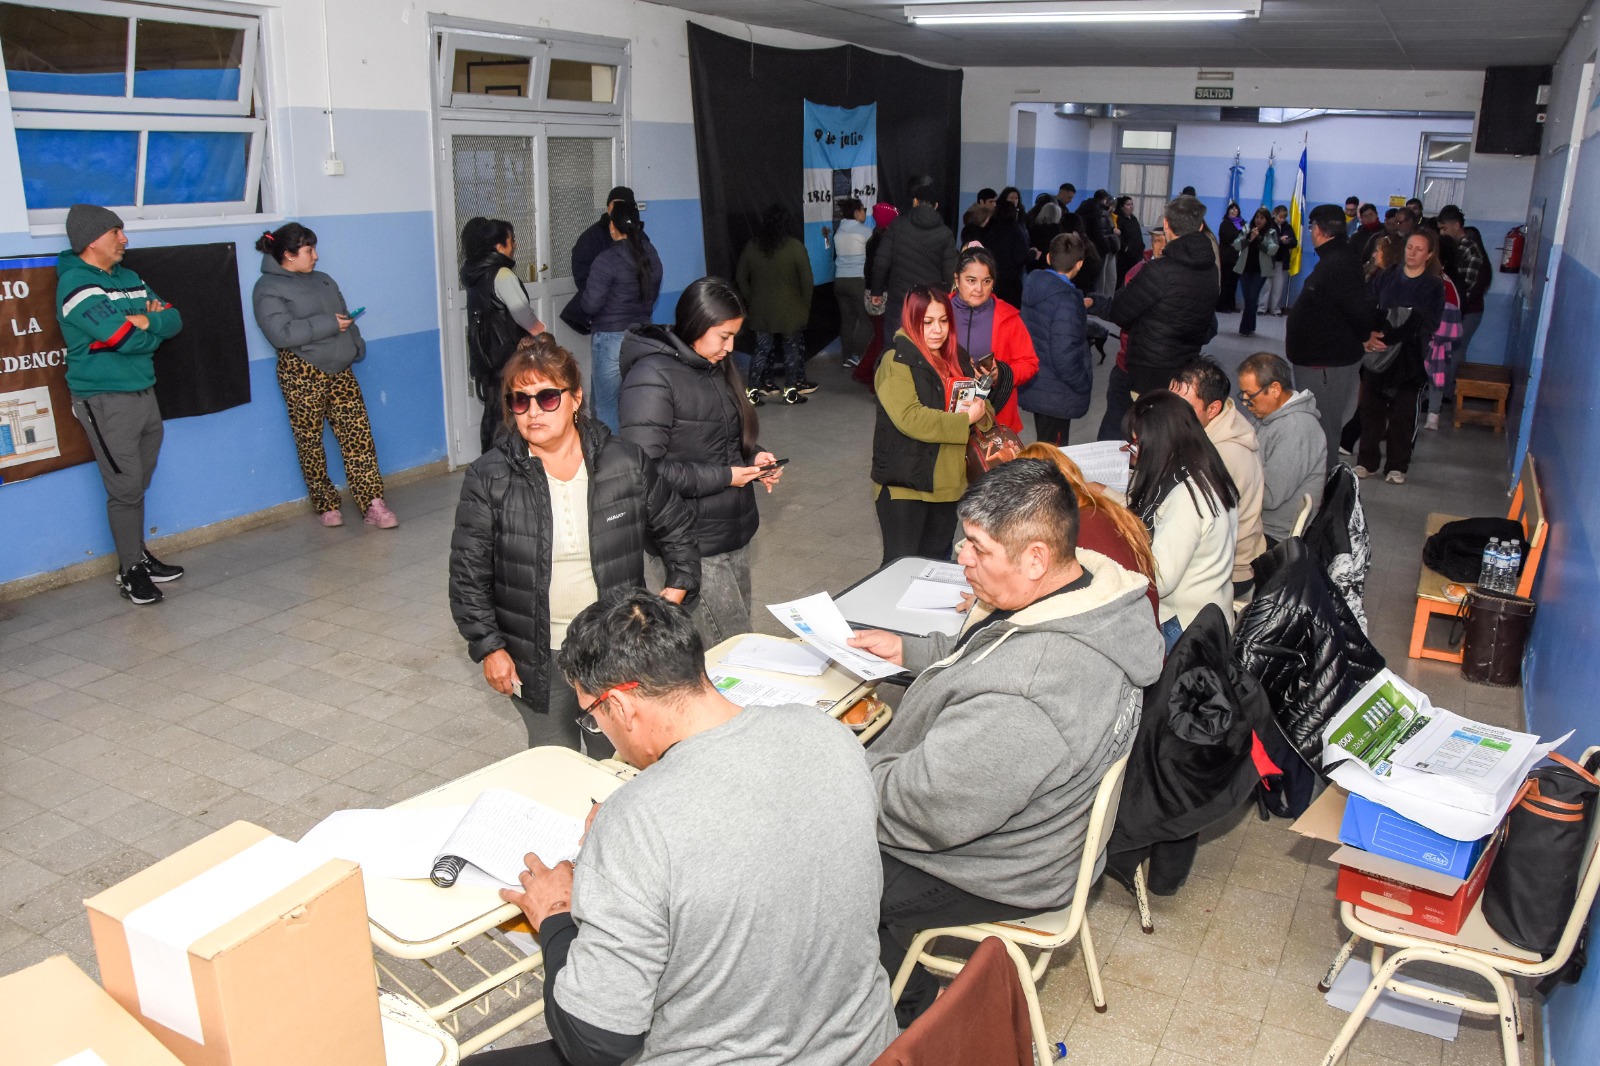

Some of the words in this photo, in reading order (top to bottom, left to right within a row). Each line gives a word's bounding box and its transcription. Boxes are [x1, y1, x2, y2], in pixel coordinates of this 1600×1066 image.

[1196, 88, 1231, 98] SALIDA
[814, 128, 823, 142] 9
[825, 131, 836, 145] de
[841, 131, 863, 149] julio
[0, 280, 29, 300] IO
[11, 317, 42, 336] LA
